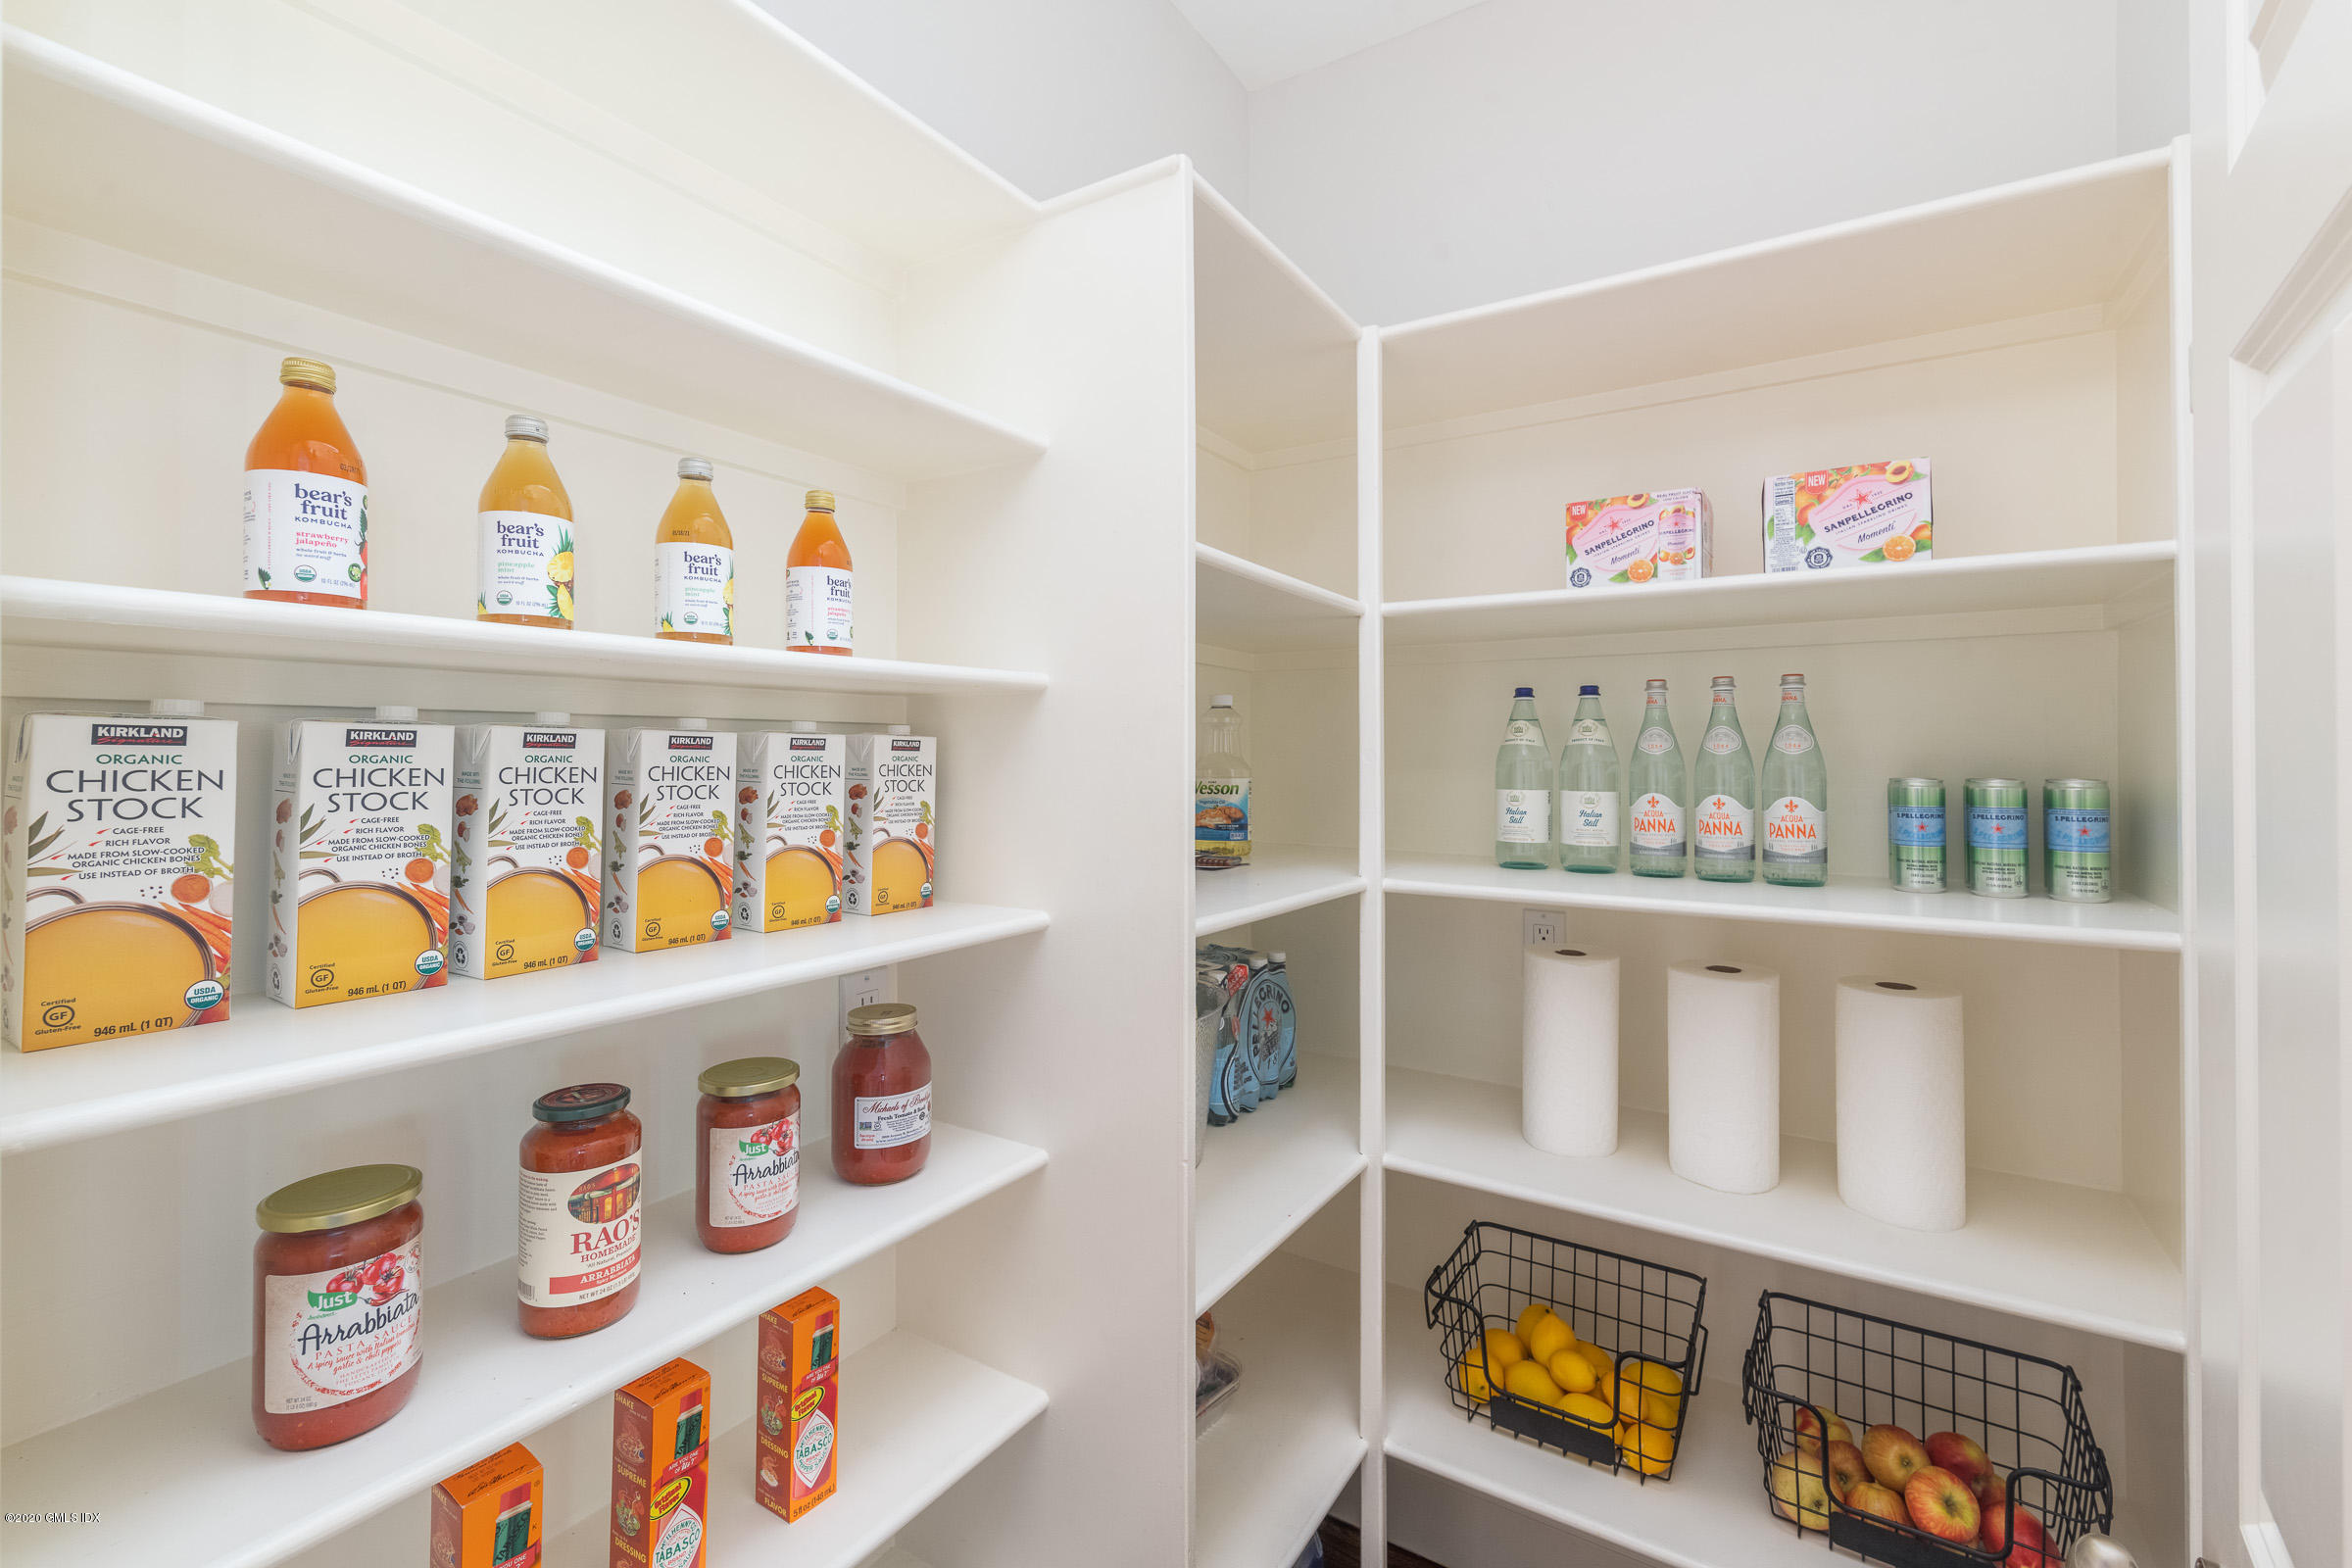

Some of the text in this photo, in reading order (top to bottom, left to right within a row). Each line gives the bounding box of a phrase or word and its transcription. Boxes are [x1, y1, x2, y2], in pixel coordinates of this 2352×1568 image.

[1808, 475, 1826, 486] NEW
[295, 483, 352, 507] bear's
[300, 500, 347, 519] fruit
[1572, 506, 1586, 515] NEW
[1824, 492, 1913, 533] SANPELLEGRINO
[295, 516, 352, 529] KOMBUCHA
[497, 520, 544, 536] bear's
[296, 531, 349, 543] strawberry
[501, 534, 539, 549] fruit
[1585, 520, 1654, 556] SANPELLEGRINO
[1858, 523, 1895, 544] Momenti
[296, 538, 337, 548] jalapeño
[684, 551, 721, 565] bear's
[1611, 549, 1640, 564] Momenti
[688, 564, 718, 575] fruit
[827, 575, 852, 588] bear's
[831, 586, 850, 598] fruit
[98, 726, 183, 737] KIRKLAND
[351, 731, 414, 740] KIRKLAND
[96, 755, 182, 764] ORGANIC
[349, 755, 414, 763] ORGANIC
[314, 768, 444, 788] CHICKEN
[499, 767, 597, 784] CHICKEN
[649, 766, 730, 781] CHICKEN
[774, 765, 840, 779] CHICKEN
[879, 764, 932, 776] CHICKEN
[46, 770, 223, 793] CHICKEN
[780, 782, 832, 796] STOCK
[885, 780, 925, 792] STOCK
[510, 788, 585, 806] STOCK
[657, 785, 719, 801] STOCK
[67, 797, 203, 822] STOCK
[327, 791, 429, 812] STOCK
[1584, 818, 1599, 827] Still
[1635, 817, 1676, 833] PANNA
[1699, 819, 1742, 836] PANNA
[1769, 823, 1816, 839] PANNA
[132, 848, 205, 857] SLOW-COOKED
[73, 859, 120, 868] ORGANIC
[78, 871, 96, 880] USE
[194, 987, 216, 996] USDA
[348, 981, 407, 997] 946 mL (1 QT)
[40, 998, 75, 1006] Certified
[190, 995, 219, 1004] ORGANIC
[50, 1012, 68, 1021] GF
[34, 1024, 81, 1035] Gluten-Free
[94, 1016, 172, 1037] 946 mL (1 QT)
[862, 1100, 909, 1113] Michaels of
[745, 1144, 766, 1153] Just
[744, 1180, 773, 1191] PASTA
[570, 1208, 640, 1254] RAO'S
[580, 1235, 636, 1262] HOMEMADE
[580, 1254, 635, 1284] ARRABBIATA
[315, 1292, 353, 1310] Just
[297, 1293, 419, 1355] Arrabbiata
[316, 1315, 413, 1360] PASTA SAUCE
[316, 1360, 333, 1371] spicy
[336, 1352, 354, 1363] sauce
[357, 1344, 372, 1356] with
[374, 1337, 393, 1352] Italian
[333, 1360, 354, 1375] garlic
[366, 1350, 380, 1361] chili
[761, 1373, 788, 1394] SUPREME
[615, 1393, 634, 1409] SHAKE
[795, 1391, 816, 1411] Original
[798, 1400, 815, 1418] Flavor
[760, 1437, 789, 1459] DRESSING
[796, 1433, 833, 1460] TABASCO
[799, 1446, 828, 1472] PEPPER SAUCE
[806, 1451, 821, 1462] BRAND
[616, 1465, 647, 1488] SUPREME
[654, 1482, 681, 1509] Original
[659, 1493, 680, 1514] Flavor
[794, 1484, 835, 1517] 5 fl oz (148 mL)
[764, 1497, 787, 1517] FLAVOR
[614, 1537, 647, 1563] DRESSING
[656, 1528, 701, 1563] TABASCO
[514, 1553, 526, 1564] ONE
[667, 1551, 687, 1565] BRAND
